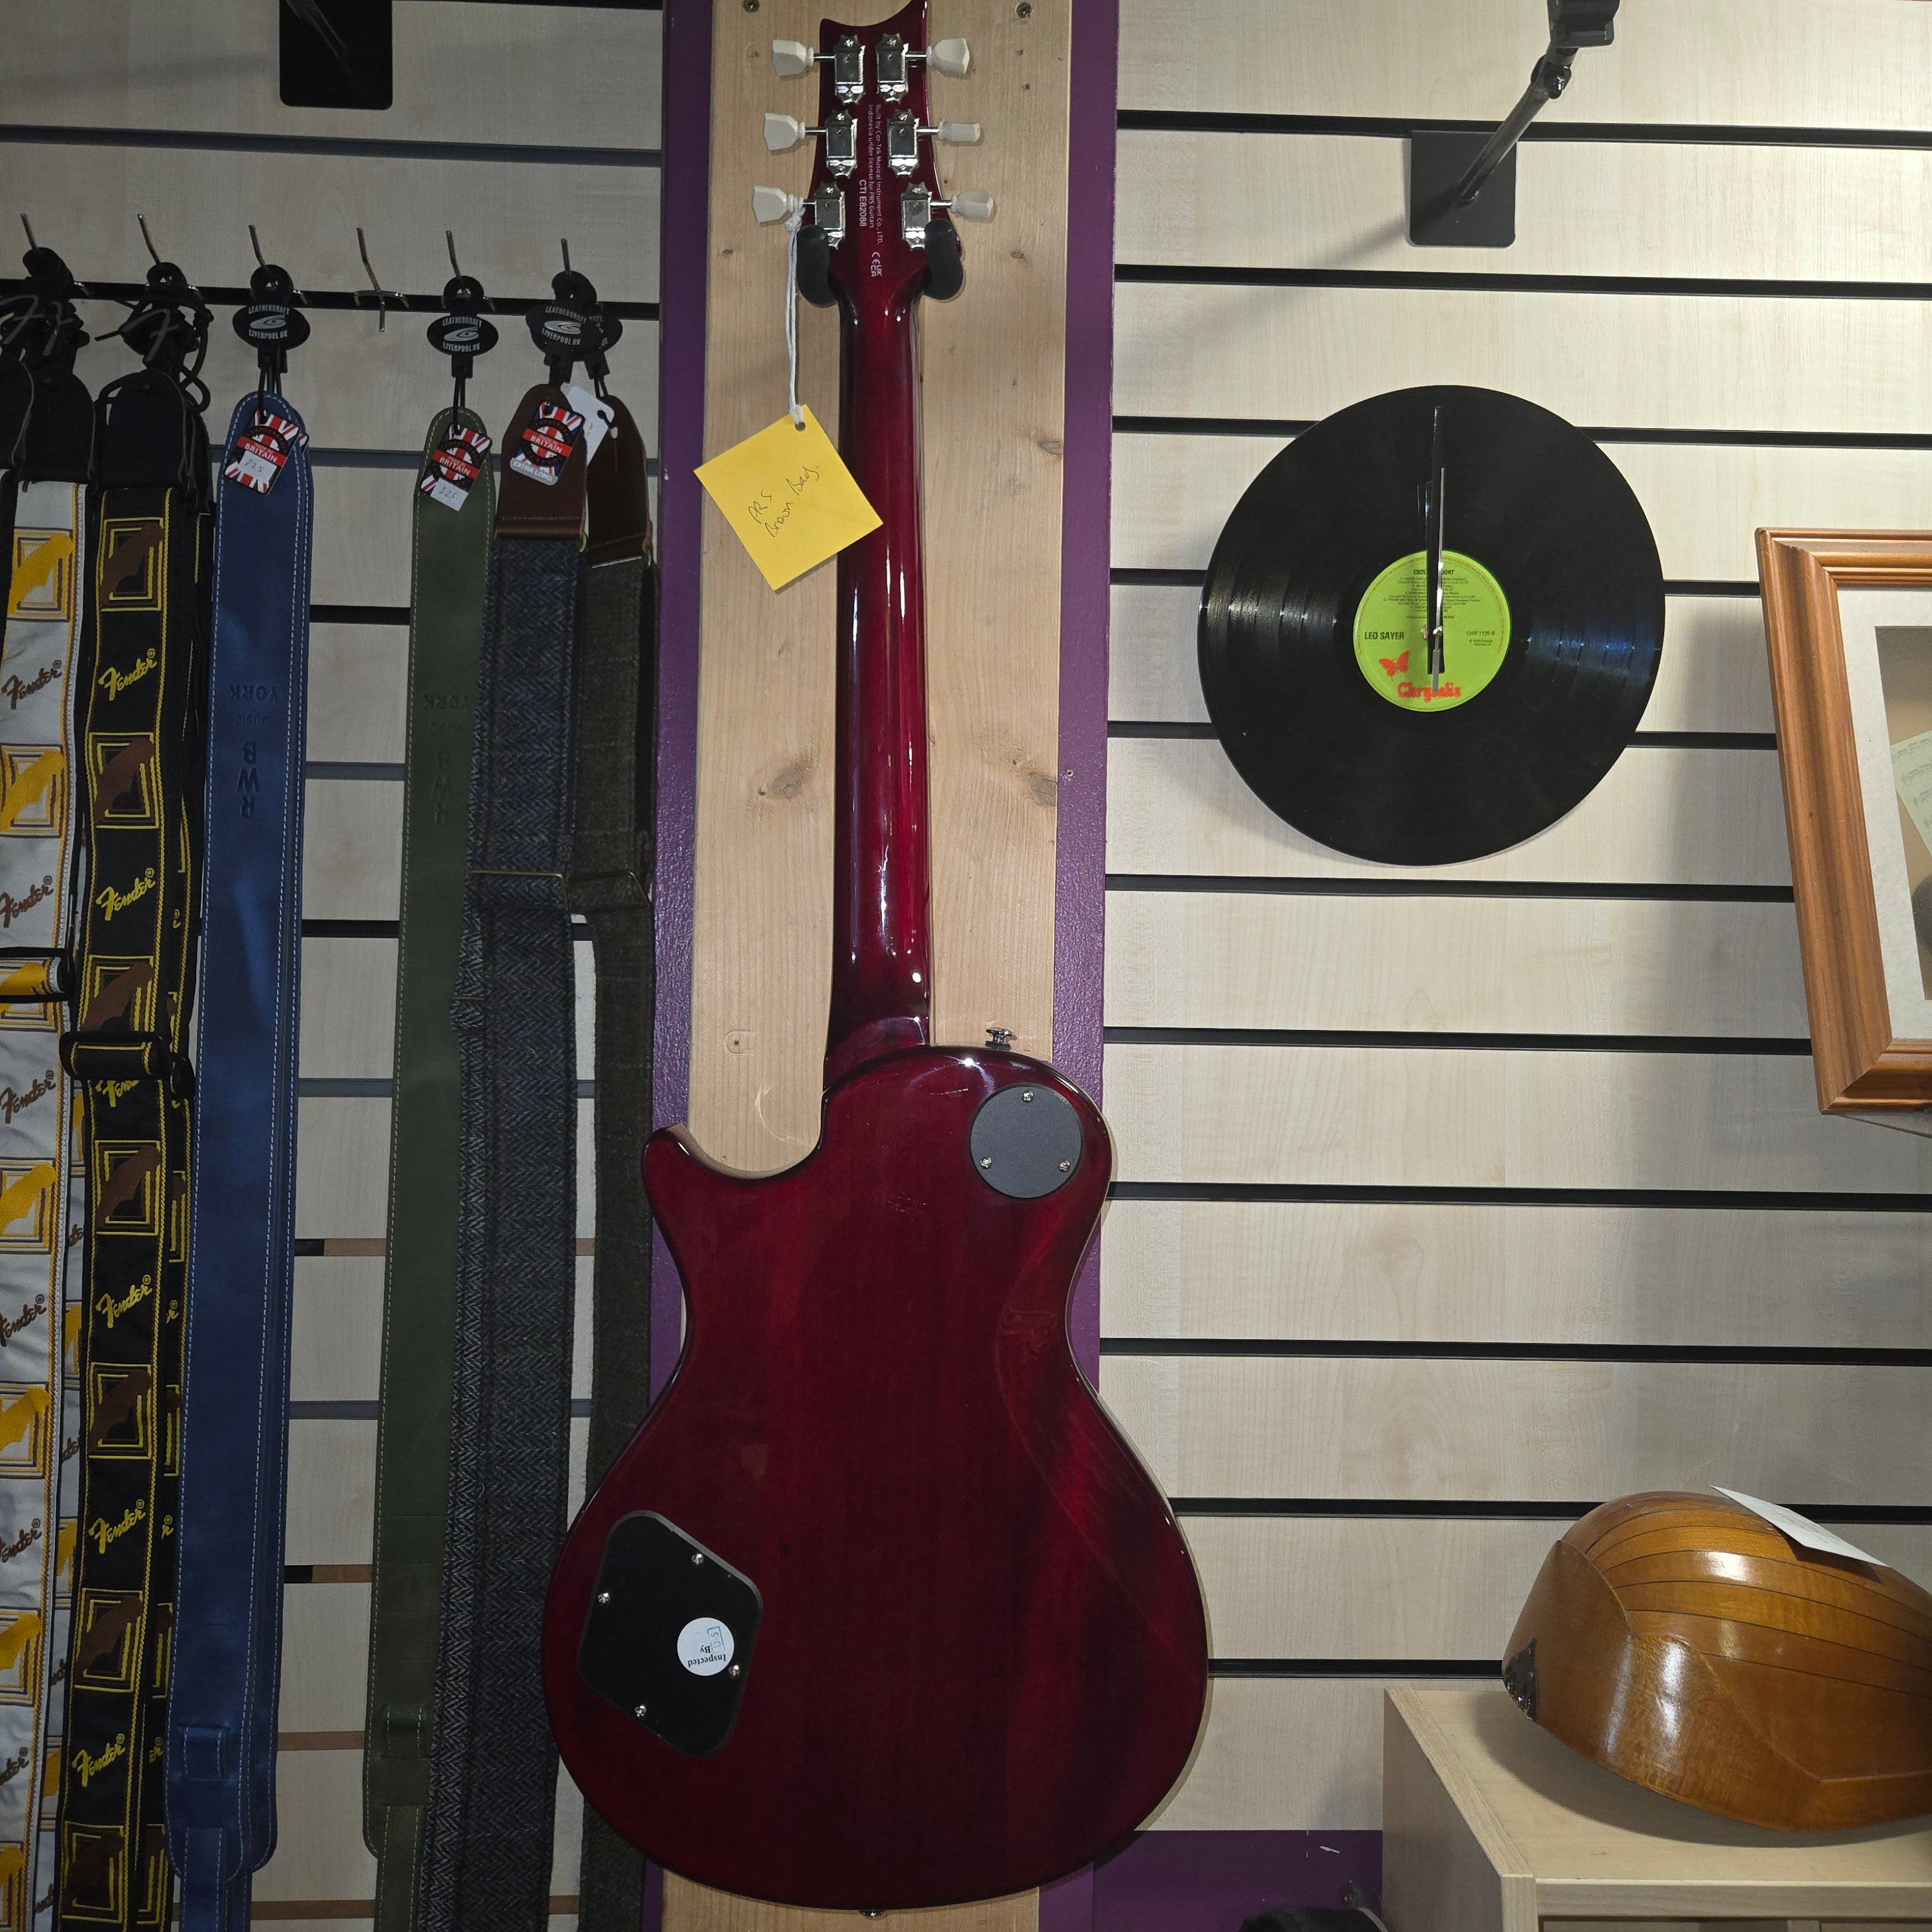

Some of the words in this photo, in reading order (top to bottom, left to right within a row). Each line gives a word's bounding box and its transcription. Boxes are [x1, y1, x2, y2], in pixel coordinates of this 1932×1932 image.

[875, 121, 882, 129] by
[249, 329, 279, 339] LIVERPOOL
[542, 328, 571, 345] LIVERPOOL
[442, 341, 471, 352] LIVERPOOL
[530, 435, 562, 453] BRITAIN
[245, 443, 278, 463] BRITAIN
[439, 457, 471, 476] BRITAIN
[513, 461, 534, 473] EXTRA
[534, 469, 553, 482] LONG
[1380, 632, 1404, 640] SAYER
[229, 683, 278, 702] YORK
[699, 1645, 711, 1654] By
[688, 1654, 726, 1668] Inspected
